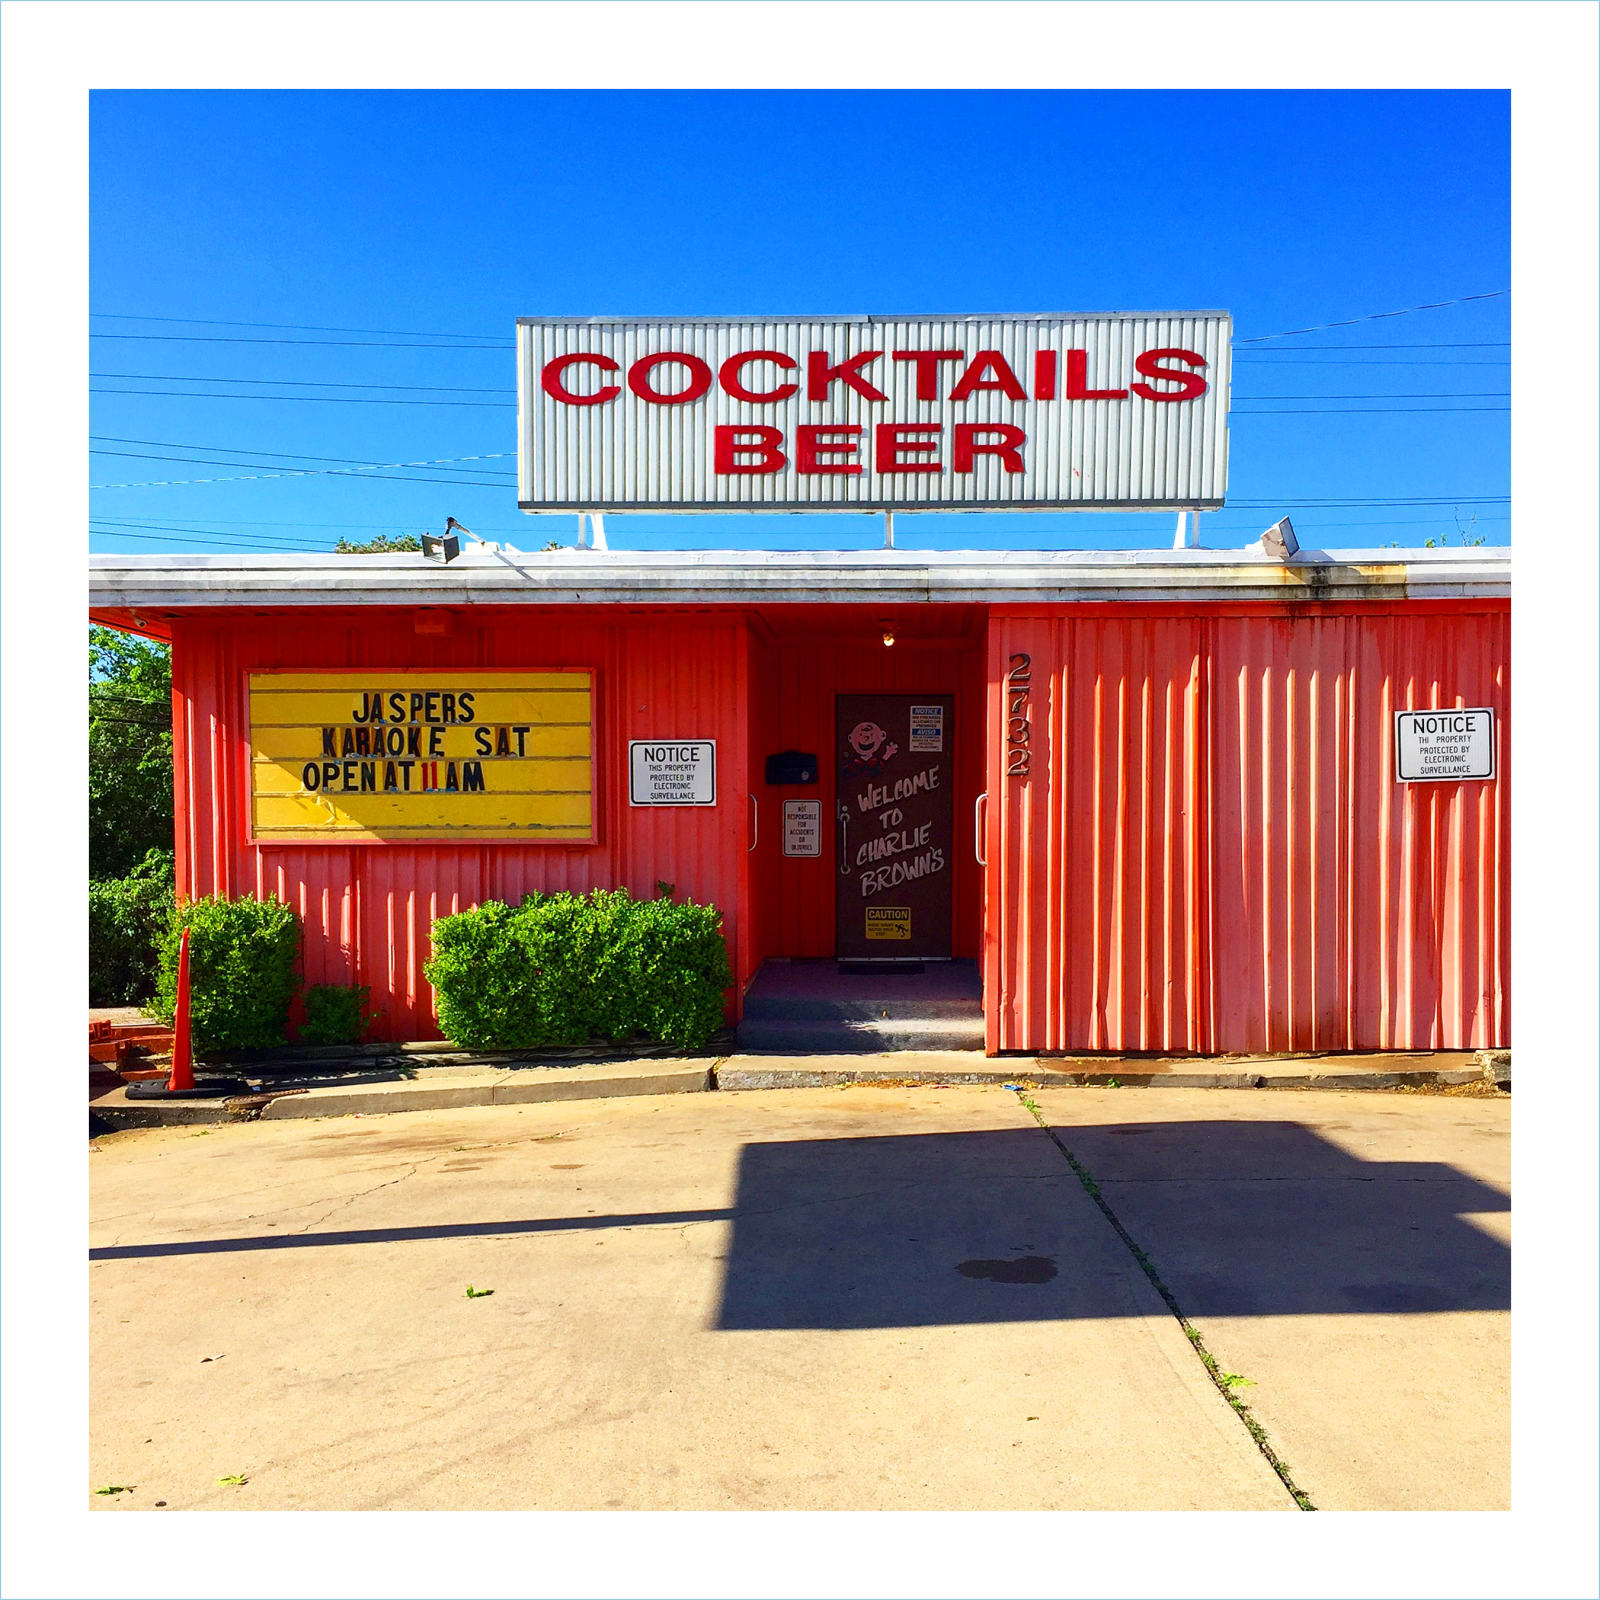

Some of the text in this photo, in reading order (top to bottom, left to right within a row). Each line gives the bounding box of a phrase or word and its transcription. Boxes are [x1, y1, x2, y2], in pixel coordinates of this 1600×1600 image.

[540, 349, 1208, 406] COCKTAILS
[713, 423, 1026, 475] BEER
[352, 692, 475, 723] JASPERS
[1007, 653, 1031, 776] 2732
[1413, 716, 1476, 734] NOTICE
[1436, 735, 1472, 743] PROPERTY
[321, 727, 531, 758] KARAOKE SAT
[645, 747, 700, 762] NOTICE
[1420, 746, 1458, 754] PROTECTED
[1420, 765, 1471, 774] SURVEILLANCE
[1424, 755, 1466, 763] ELECTRONIC
[302, 762, 486, 791] OPEN AT 11 AM
[857, 764, 940, 812] WELCOME
[879, 807, 903, 829] TO
[856, 821, 933, 866] CHARLIE
[859, 845, 945, 897] BROWN'S
[868, 910, 908, 919] CAUTION
